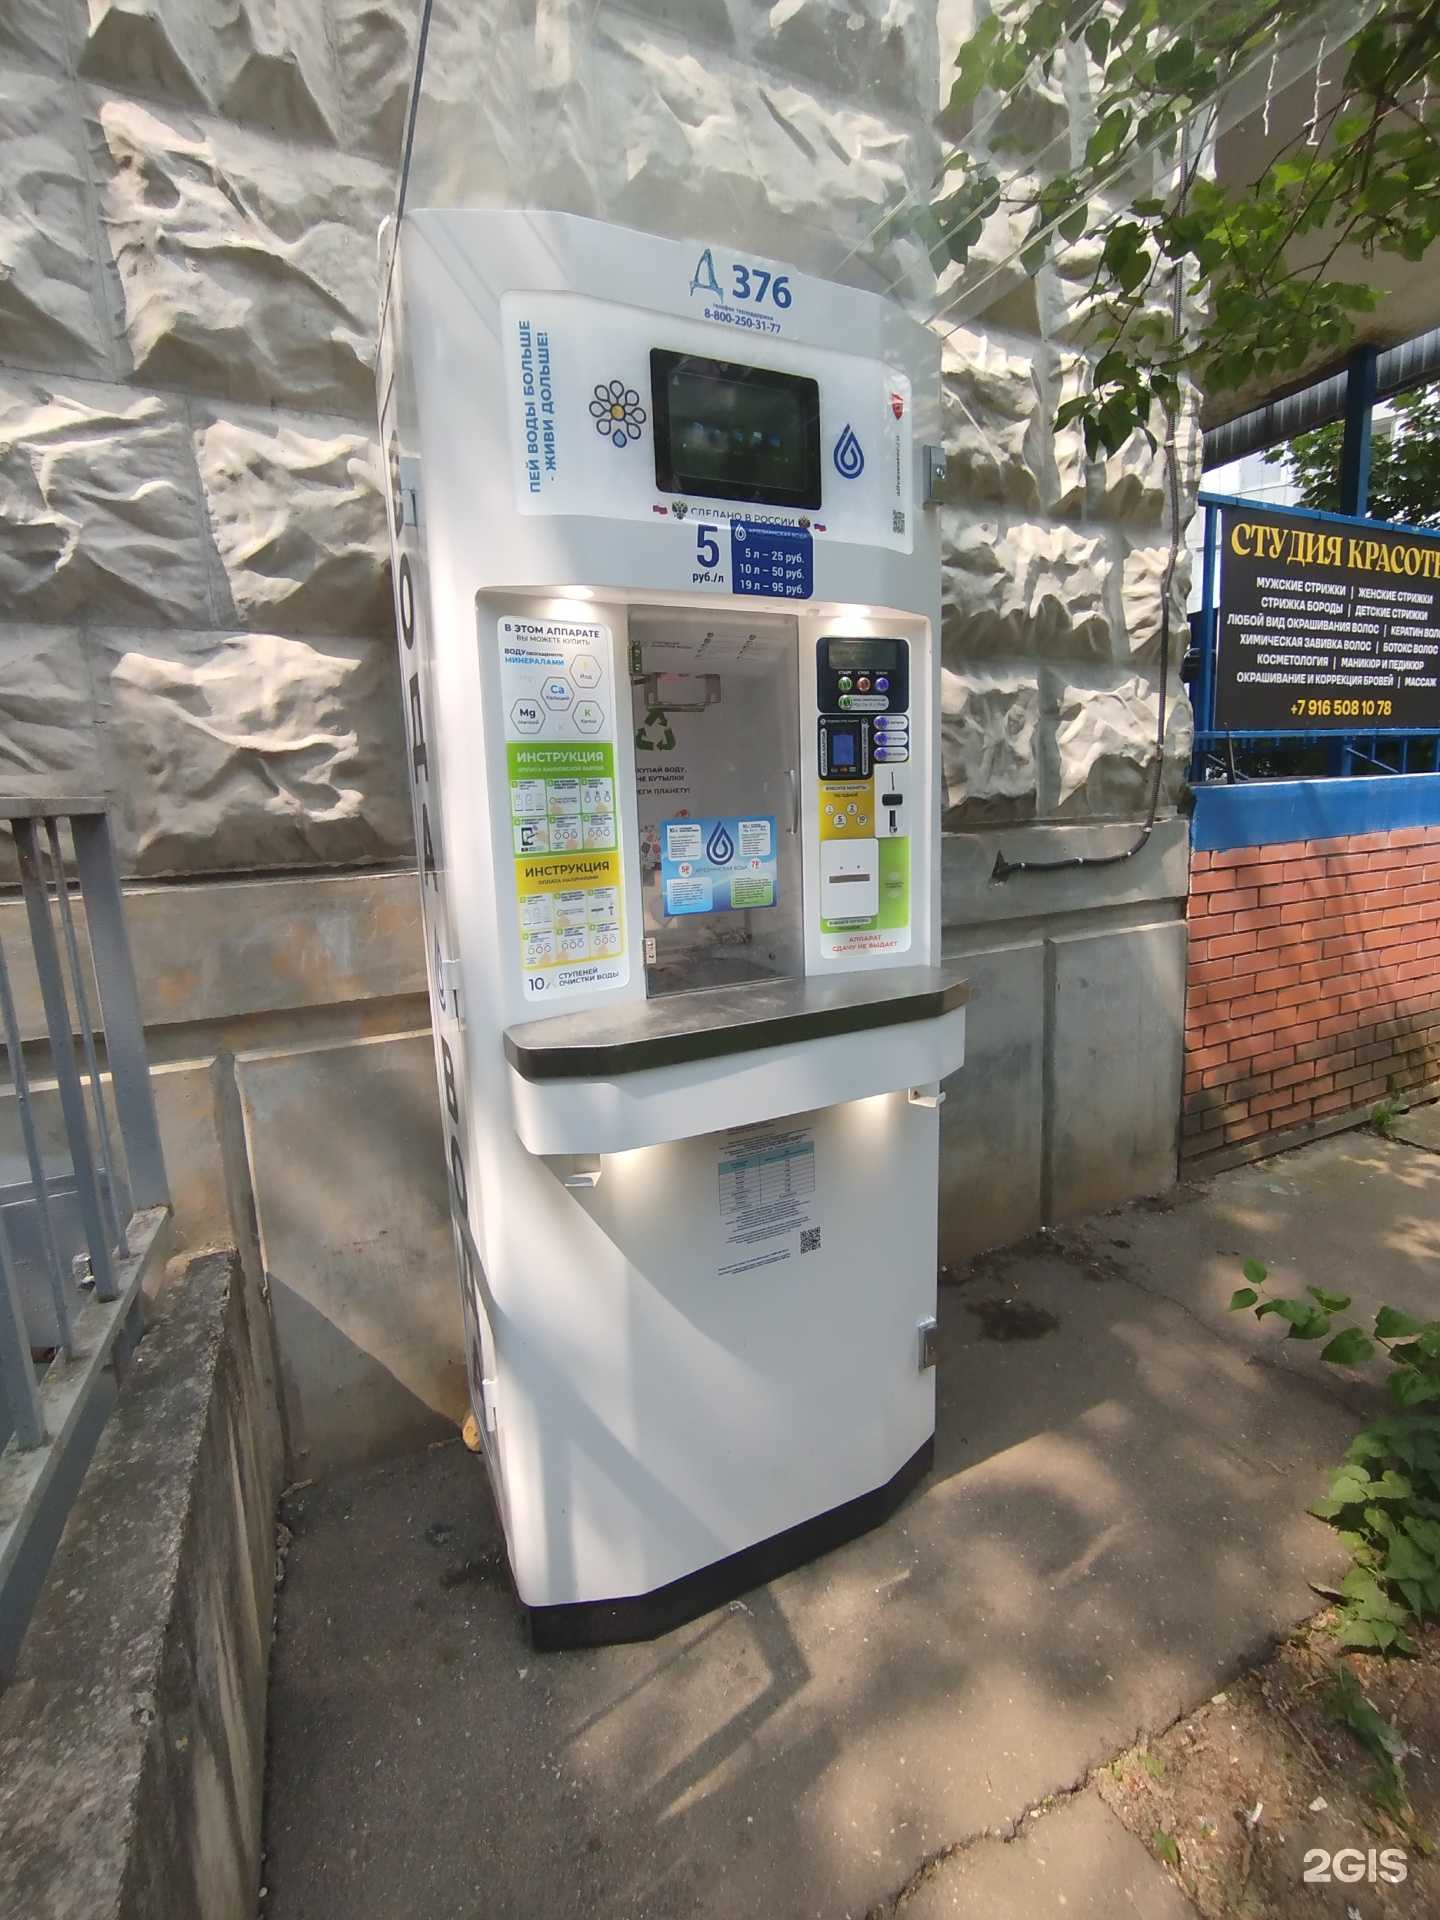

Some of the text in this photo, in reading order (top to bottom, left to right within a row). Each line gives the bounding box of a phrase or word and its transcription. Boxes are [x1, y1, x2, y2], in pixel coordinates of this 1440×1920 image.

[732, 264, 792, 309] 376
[704, 308, 781, 333] 8-800-250-31-77
[537, 332, 555, 414] ДОЛЬШЕ!
[519, 320, 541, 492] ПЕЙ ВОДЫ БОЛЬШЕ
[543, 419, 557, 471] ЖИВИ
[754, 515, 796, 526] РОССИИ
[697, 524, 720, 568] 5
[1231, 523, 1343, 567] СТУДИЯ
[745, 549, 751, 558] 5
[753, 551, 760, 559] л
[771, 551, 783, 561] 25
[785, 552, 805, 565] руб.
[692, 572, 724, 584] руб./л
[739, 564, 751, 575] 10
[753, 567, 760, 575] л
[772, 567, 784, 577] 50
[785, 568, 805, 581] руб.
[740, 580, 752, 590] 19
[754, 583, 760, 591] л
[772, 583, 784, 593] 95
[786, 584, 805, 597] руб.
[1256, 576, 1433, 604] МУЖСКИЕ СТРИЖКИ ЖЕНСКИЕ СТРИЖКИ
[1261, 597, 1428, 620] СТРИЖКА БОРОДЫ ДЕТСКИЕ СТРИЖКИ
[514, 624, 544, 634] ЭТОМ
[546, 627, 601, 638] АППАРАТЕ
[1227, 613, 1265, 626] ЛЮБОЙ
[1266, 616, 1285, 629] ВИД
[1287, 618, 1351, 632] ОКРАШИВАНИЯ
[1351, 623, 1379, 634] ВОЛОС
[1391, 626, 1423, 637] КЕРАТИН
[529, 636, 561, 644] МОЖЕТЕ
[562, 638, 591, 646] КУПИТЬ
[1240, 633, 1439, 655] ХИМИЧЕСКАЯ ЗАВИВКА ВОЛОС БОТОКС ВОЛОС
[504, 648, 526, 656] ВОДУ
[505, 657, 565, 666] МИНЕРАЛАМИ
[1257, 654, 1424, 671] КОСМЕТОЛОГИЯ МАНИКЮР И ПЕДИКЮР
[1237, 672, 1437, 687] ОКРАШИВАНИЕ И КОРРЕКЦИЯ БРОВЕЙ МАССАЖ
[550, 685, 565, 695] Ca
[519, 709, 536, 719] Mg
[1291, 700, 1392, 715] +7 916 508 10 78
[516, 751, 604, 763] ИНСТРУКЦИЯ
[525, 861, 610, 878] ИНСТРУКЦИЯ
[849, 935, 881, 943] АППАРАТ
[832, 944, 857, 952] СДАЧУ
[558, 967, 598, 980] СТУПЕНЕЙ
[559, 971, 619, 987] ОЧИСТКИ ВОДЫ
[528, 977, 545, 991] 10
